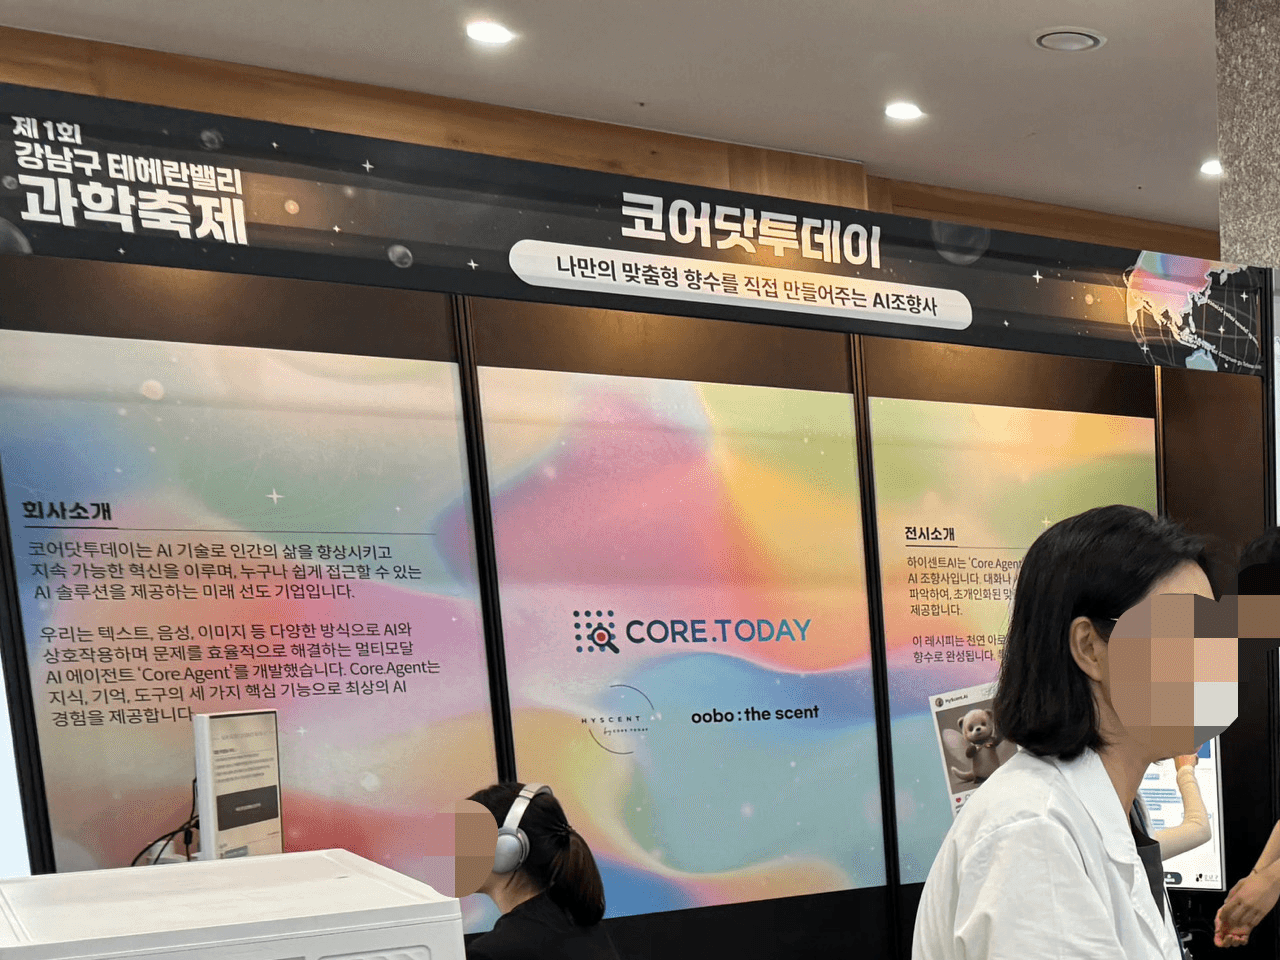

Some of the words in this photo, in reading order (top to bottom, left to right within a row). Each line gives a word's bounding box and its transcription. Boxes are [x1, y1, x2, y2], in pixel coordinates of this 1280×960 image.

[11, 115, 40, 139] 제
[43, 120, 82, 145] 1회
[14, 140, 102, 177] 강남구
[107, 153, 242, 195] 테헤란밸리
[18, 173, 249, 246] 과학축제
[621, 191, 881, 269] 코어닷투데이
[556, 254, 616, 282] 나만의
[622, 262, 679, 288] 맞춤형
[684, 267, 739, 294] 향수를
[744, 275, 779, 298] 직접
[783, 278, 867, 308] 만들어주는
[872, 294, 939, 317] AI조향사
[22, 501, 112, 521] 회사소개
[905, 526, 955, 541] 전시소개
[29, 541, 153, 559] 코어닷투데이는
[157, 543, 172, 558] AI
[177, 543, 227, 559] 기술로
[230, 543, 277, 560] 인간의
[282, 544, 313, 560] 삶을
[316, 544, 392, 561] 향상시키고
[30, 563, 67, 579] 지속
[72, 563, 124, 579] 가능한
[129, 563, 179, 579] 혁신을
[240, 564, 288, 580] 누구나
[292, 564, 323, 580] 쉽게
[326, 564, 371, 580] 접근할
[375, 565, 390, 580] 수
[393, 564, 422, 580] 있는
[907, 556, 967, 570] 하이센트AI는
[908, 573, 918, 584] AI
[983, 573, 1011, 585] 대화나
[34, 584, 51, 599] AI
[56, 584, 126, 600] 솔루션을
[131, 584, 199, 600] 제공하는
[203, 584, 235, 600] 미래
[239, 584, 271, 600] 선도
[275, 584, 355, 600] 기업입니다.
[909, 588, 952, 600] 파악하여,
[954, 588, 1001, 601] 초개인화된
[910, 604, 963, 616] 제공합니다.
[40, 626, 94, 643] 우리는
[98, 626, 154, 642] 텍스트,
[157, 624, 194, 641] 음성,
[198, 624, 246, 640] 이미지
[250, 624, 266, 640] 등
[270, 623, 317, 639] 다양한
[320, 622, 381, 638] 방식으로
[384, 622, 412, 637] AI와
[626, 618, 811, 644] CORE.TODAY
[912, 635, 922, 647] 이
[925, 635, 965, 647] 레시피는
[967, 635, 985, 646] 천연
[42, 646, 148, 665] 상호작용하며
[153, 645, 203, 662] 문제를
[207, 643, 287, 661] 효율적으로
[290, 642, 352, 658] 해결하는
[355, 641, 413, 657] 멀티모달
[913, 651, 944, 663] 향수로
[46, 670, 61, 684] AI
[66, 668, 136, 684] 에이전트
[253, 662, 346, 679] 개발했습니다.
[49, 690, 88, 706] 지식,
[92, 688, 130, 704] 기억,
[134, 686, 184, 702] 도구의
[189, 686, 204, 701] 세
[209, 685, 240, 701] 가지
[245, 683, 276, 699] 핵심
[281, 681, 342, 698] 기능으로
[345, 680, 389, 695] 최상의
[393, 680, 407, 693] AI
[51, 710, 104, 727] 경험을
[691, 708, 734, 723] oobo
[744, 706, 771, 722] the
[775, 705, 819, 720] scent
